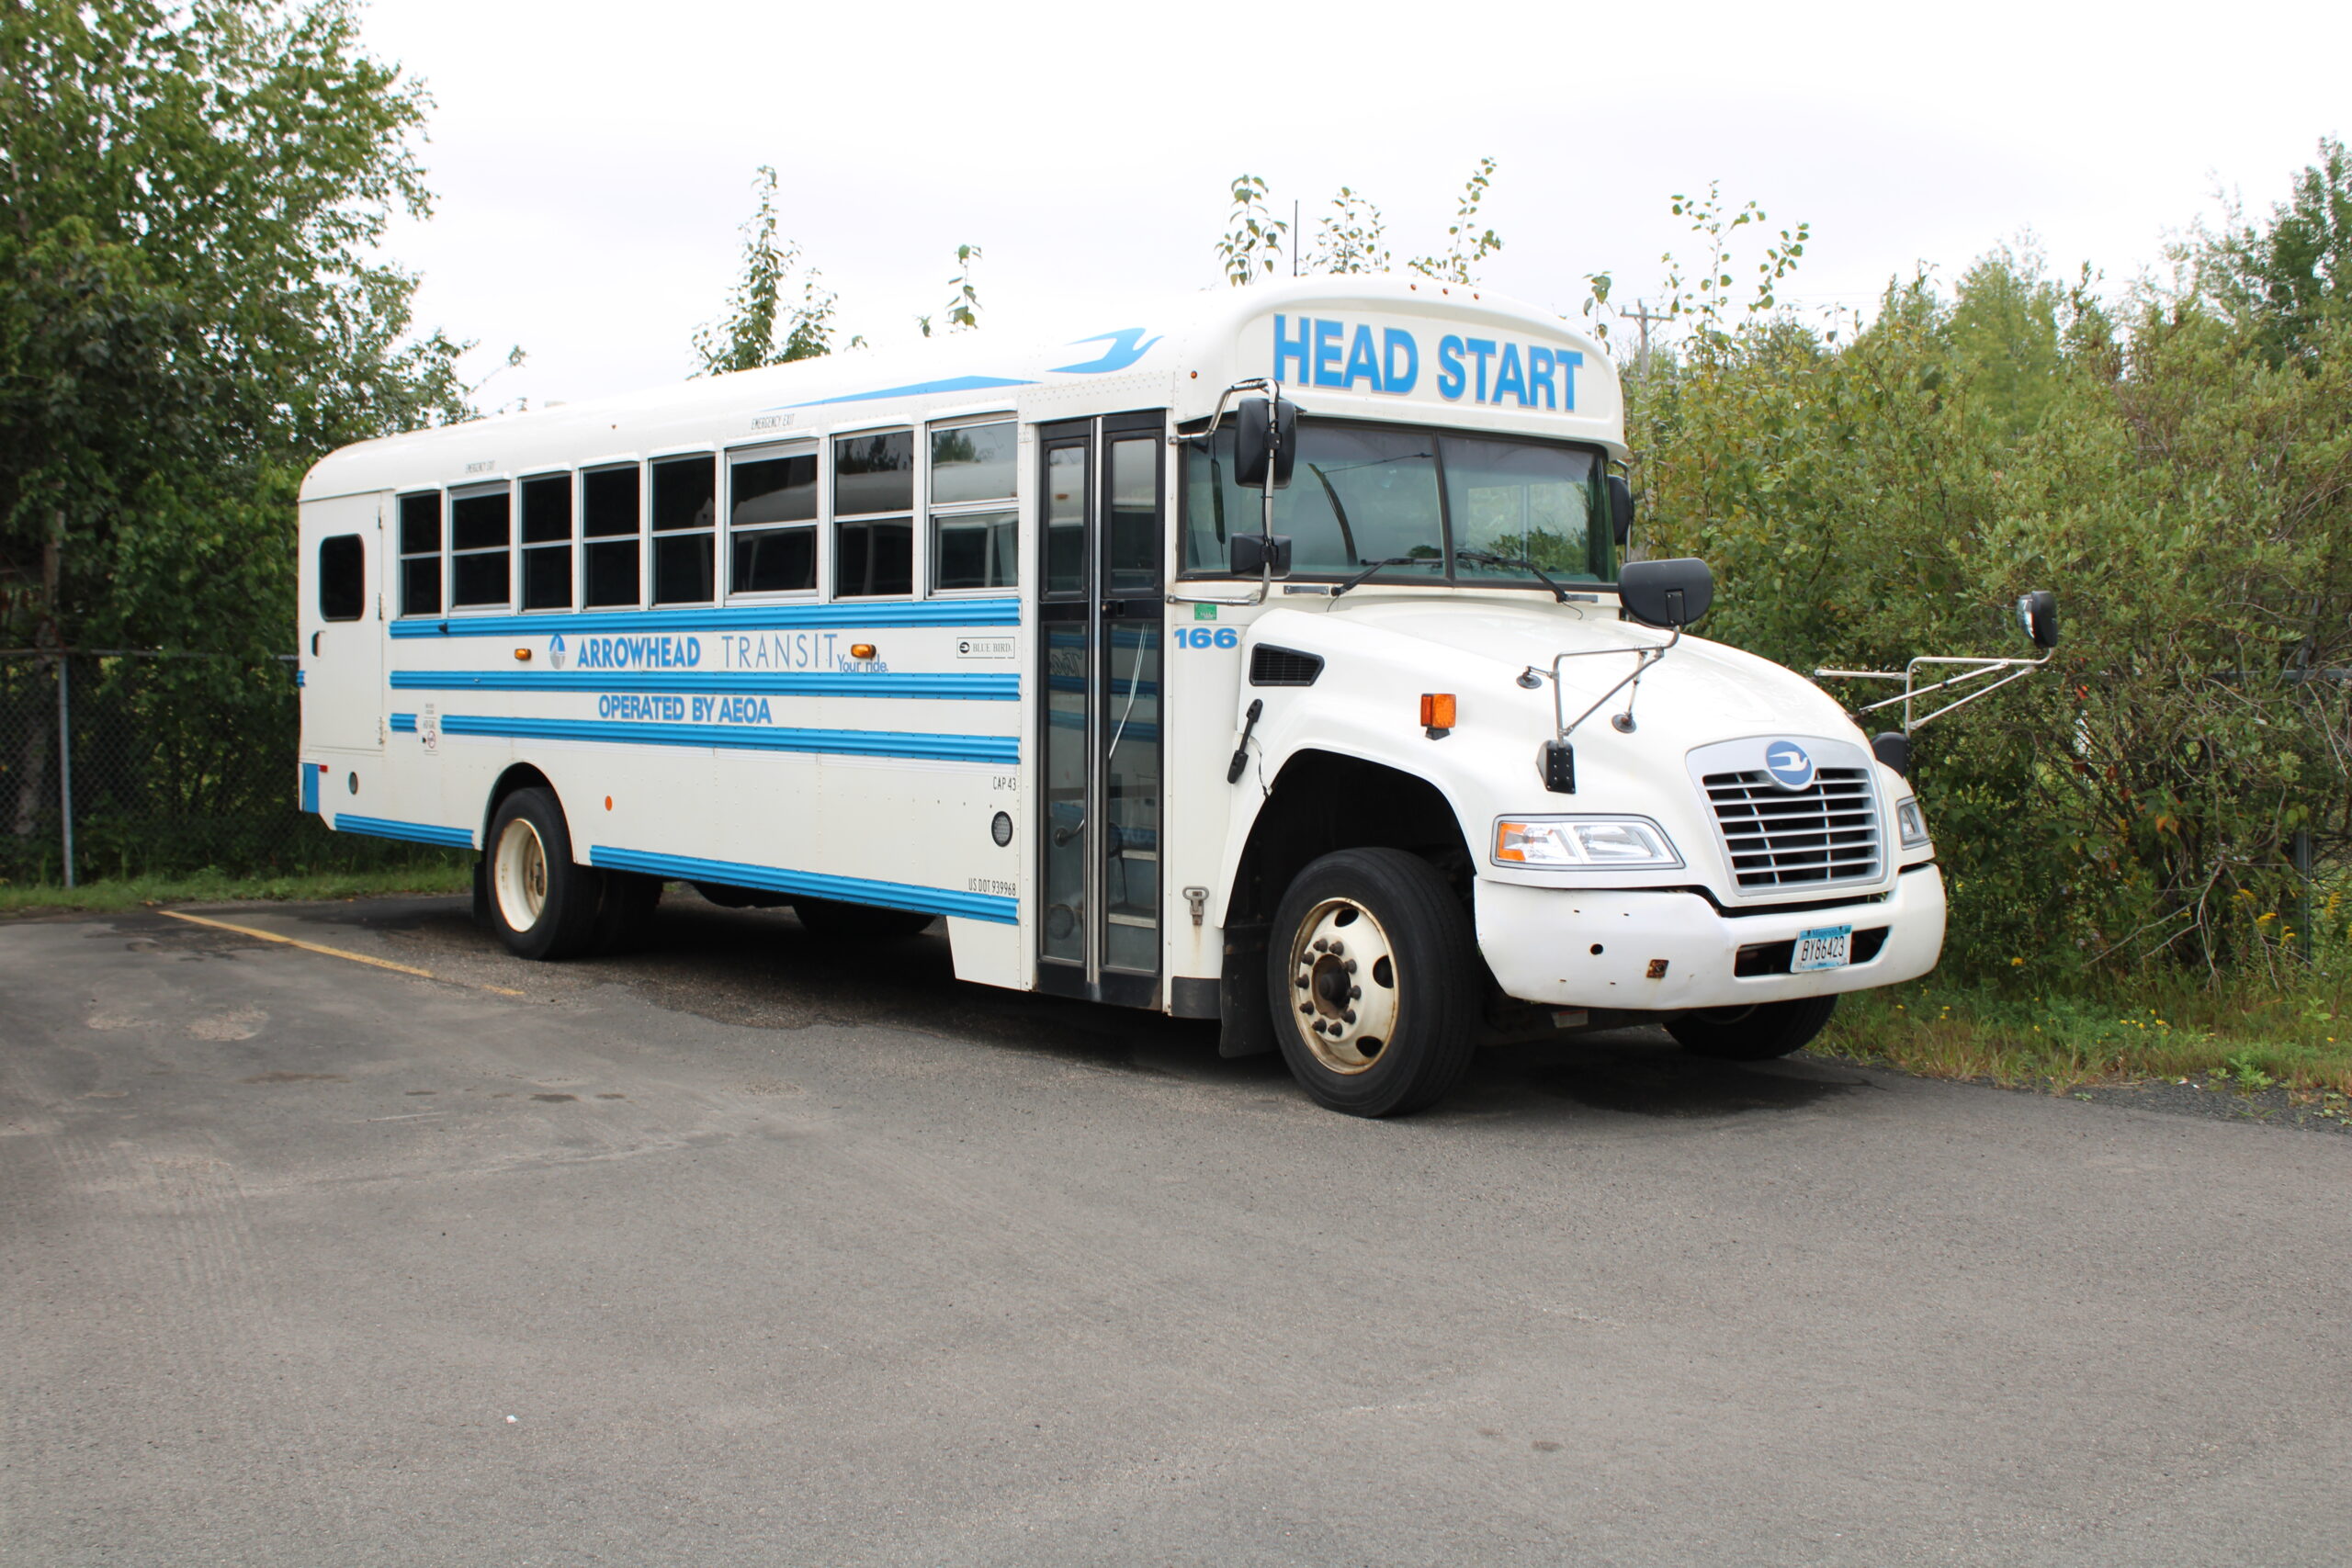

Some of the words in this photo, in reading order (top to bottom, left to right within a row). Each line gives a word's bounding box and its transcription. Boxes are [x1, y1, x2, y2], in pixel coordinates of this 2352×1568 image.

[1273, 313, 1419, 396] HEAD
[1437, 334, 1583, 412] START
[751, 416, 781, 430] EMERGENCY
[783, 413, 795, 426] EXIT
[973, 643, 991, 652] BLUE
[1174, 628, 1238, 649] 166
[577, 635, 701, 669] ARROWHEAD
[721, 634, 838, 669] TRANSIT
[837, 654, 862, 672] Your
[599, 694, 684, 721] OPERATED
[692, 696, 716, 722] BY
[718, 696, 773, 724] AEOA
[993, 776, 1006, 790] CAP
[1008, 777, 1016, 791] 43
[968, 878, 977, 891] US
[978, 879, 990, 892] DOT
[992, 881, 1016, 897] 939968
[1802, 935, 1844, 962] BY86423
